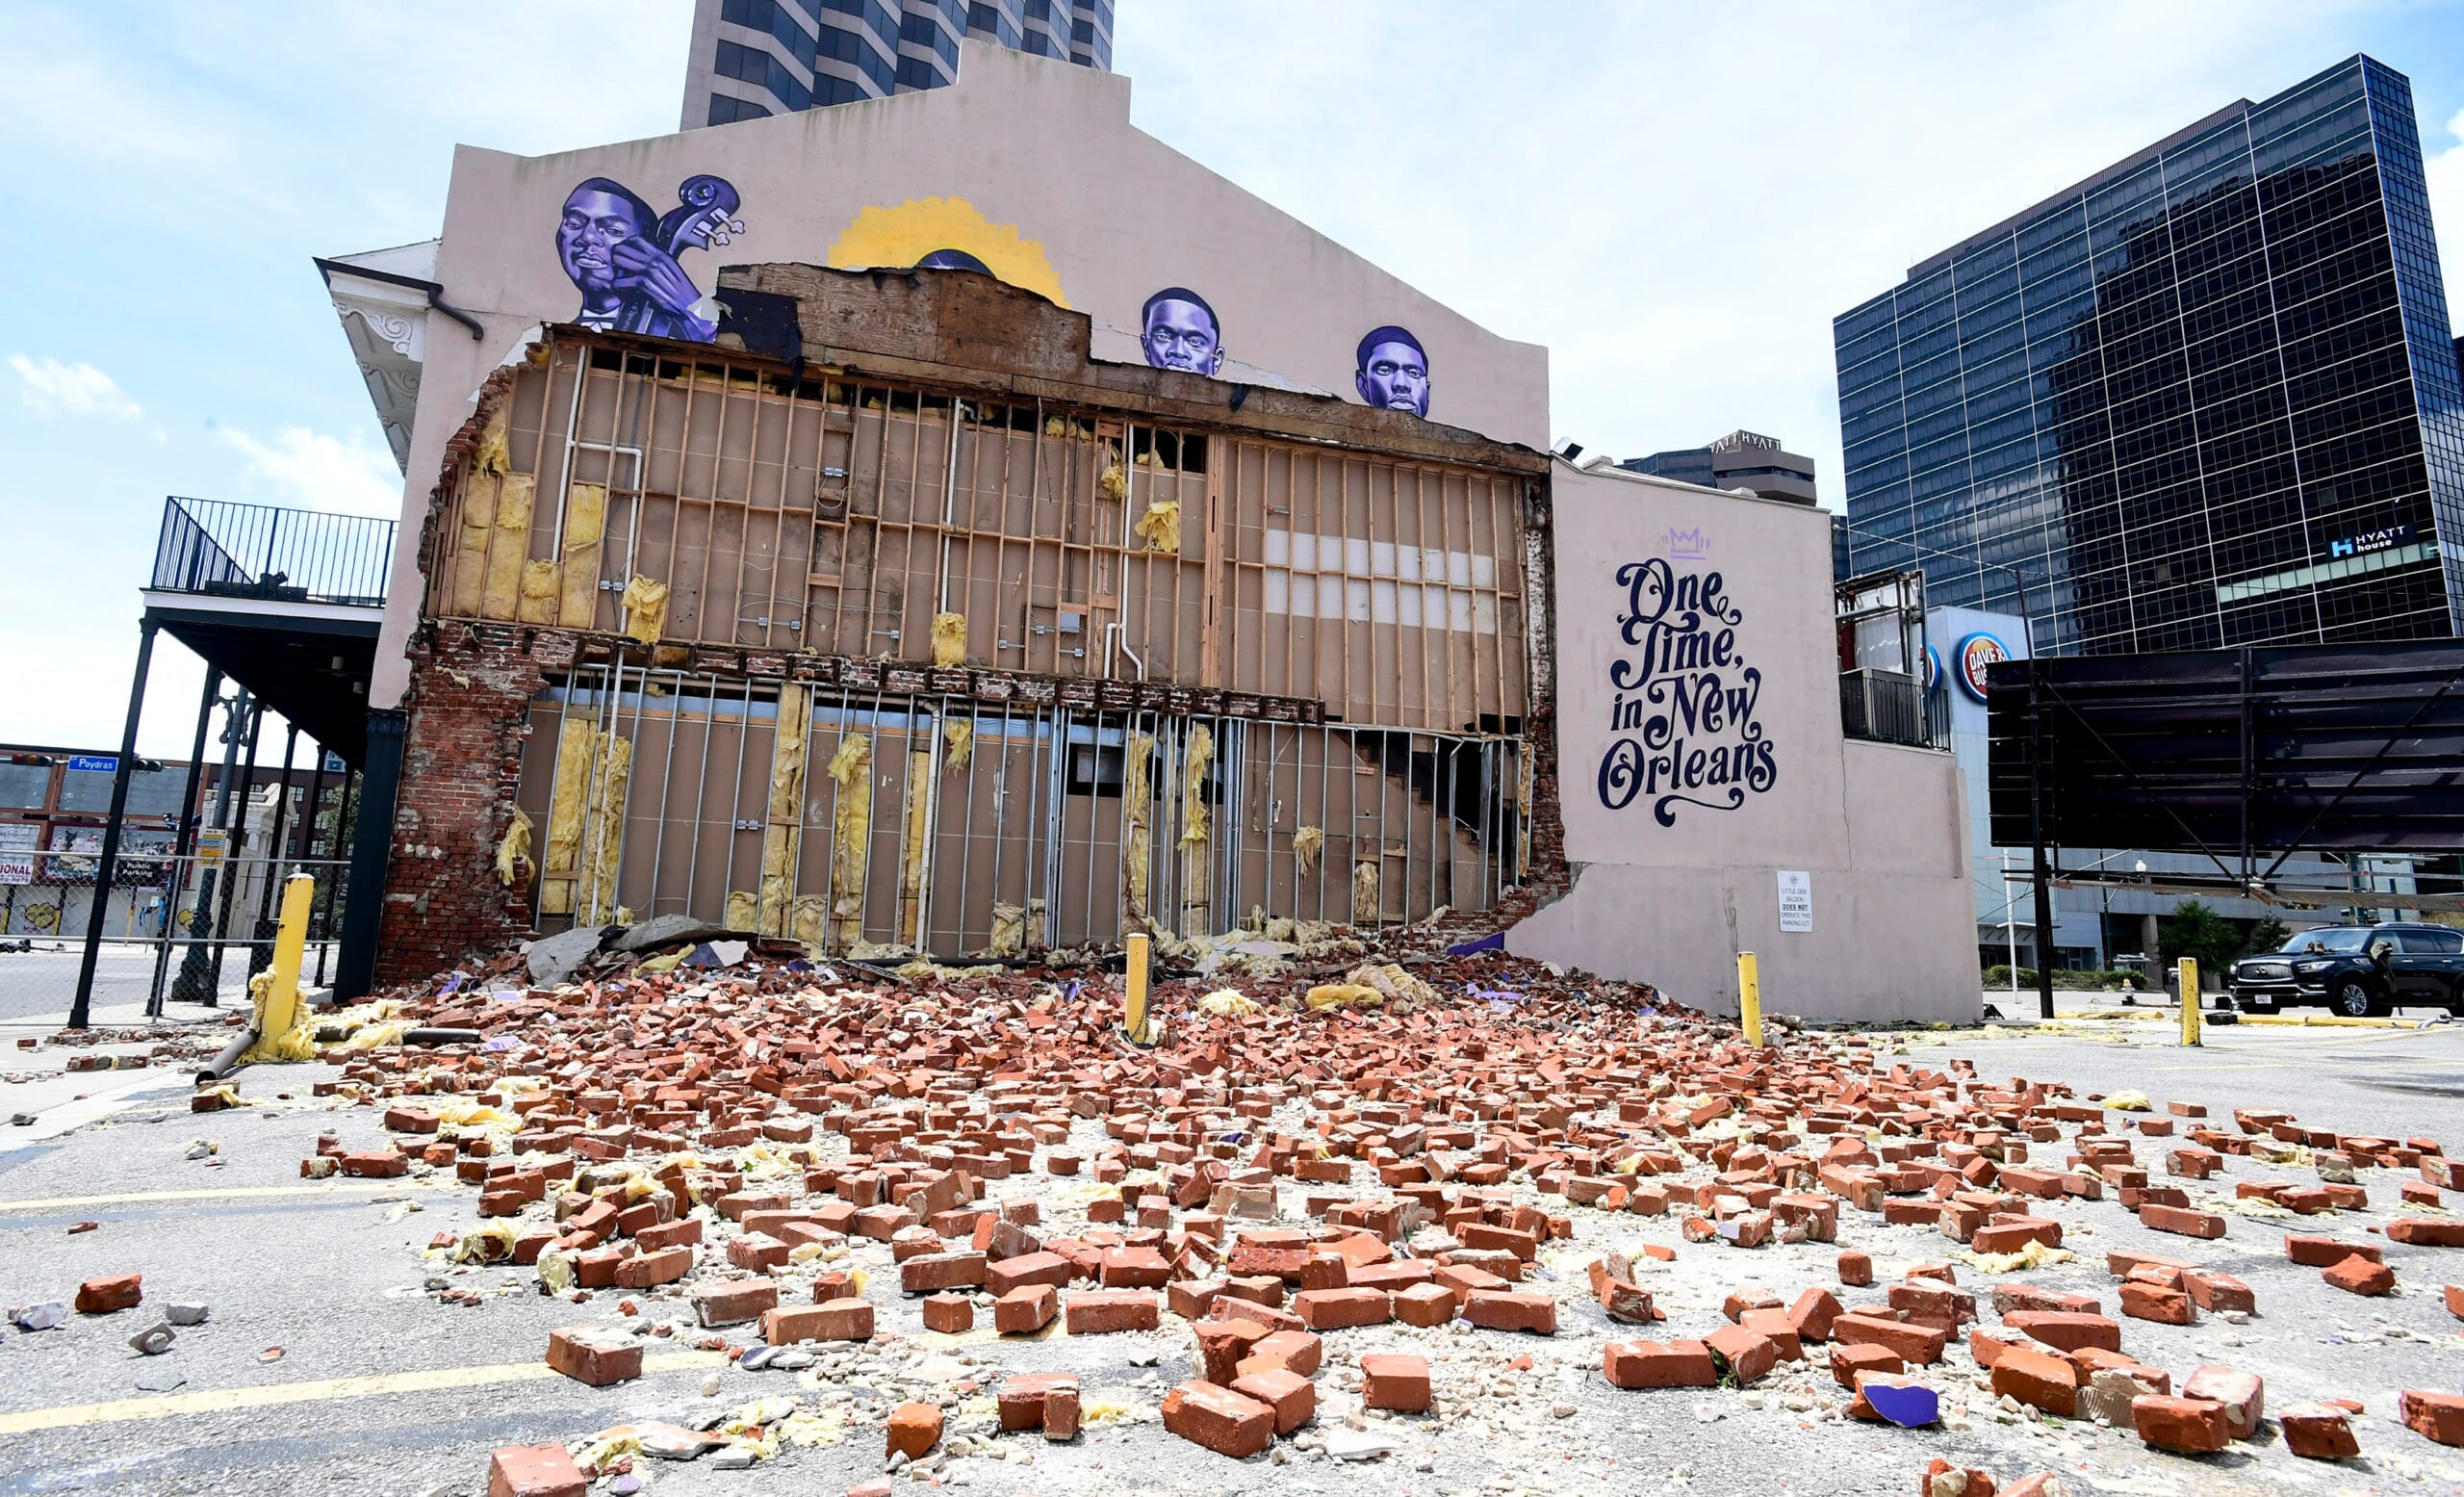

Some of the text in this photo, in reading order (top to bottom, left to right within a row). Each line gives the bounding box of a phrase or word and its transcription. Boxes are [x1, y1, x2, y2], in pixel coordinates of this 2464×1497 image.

[1709, 433, 1737, 453] YATT
[1742, 432, 1780, 451] HYATT
[2355, 525, 2405, 545] HYATT
[2357, 539, 2393, 553] house
[1616, 558, 1742, 626] One
[1610, 611, 1743, 690] Time,
[1969, 648, 1995, 670] DAVE
[1610, 667, 1762, 751] in New
[78, 758, 114, 770] Poydras
[1598, 737, 1778, 813] Orleans
[122, 868, 153, 878] Parking
[126, 862, 151, 870] Public
